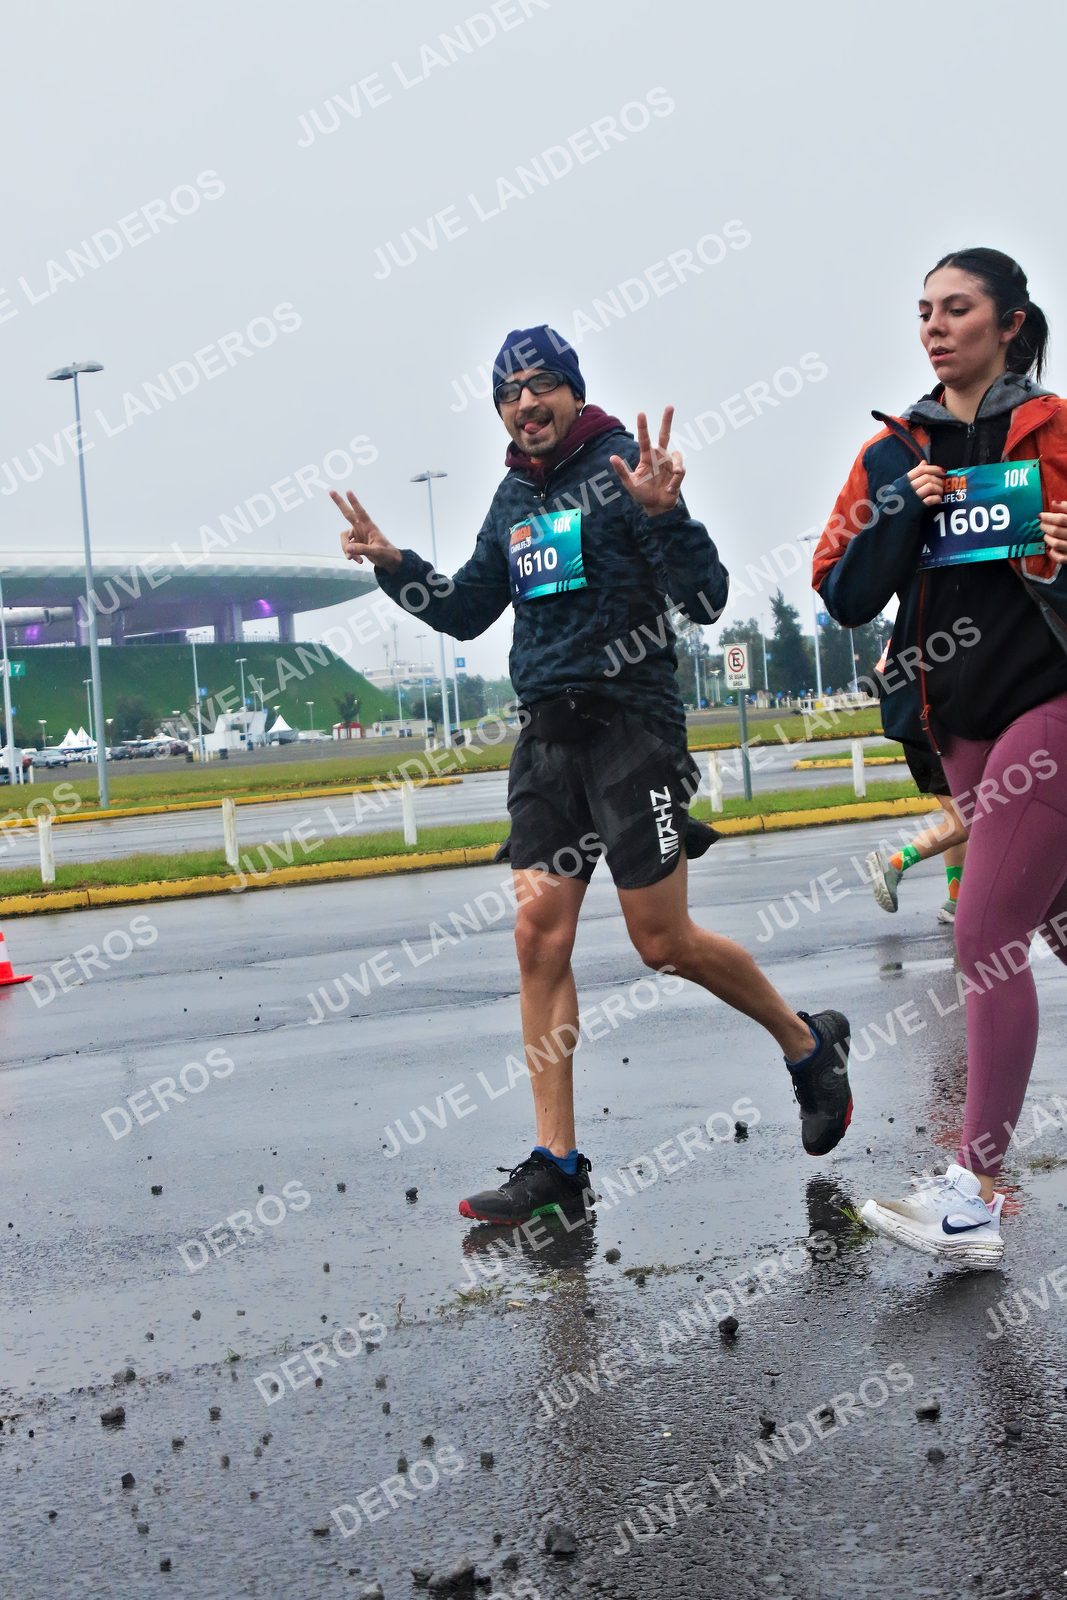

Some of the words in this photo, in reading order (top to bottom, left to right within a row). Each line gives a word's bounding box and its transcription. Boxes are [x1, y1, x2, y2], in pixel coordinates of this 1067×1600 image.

[1003, 468, 1029, 489] 10K
[553, 516, 572, 534] 10K
[932, 503, 1011, 538] 1609
[516, 547, 558, 578] 1610
[13, 664, 21, 674] 7
[649, 785, 679, 855] NIKE
